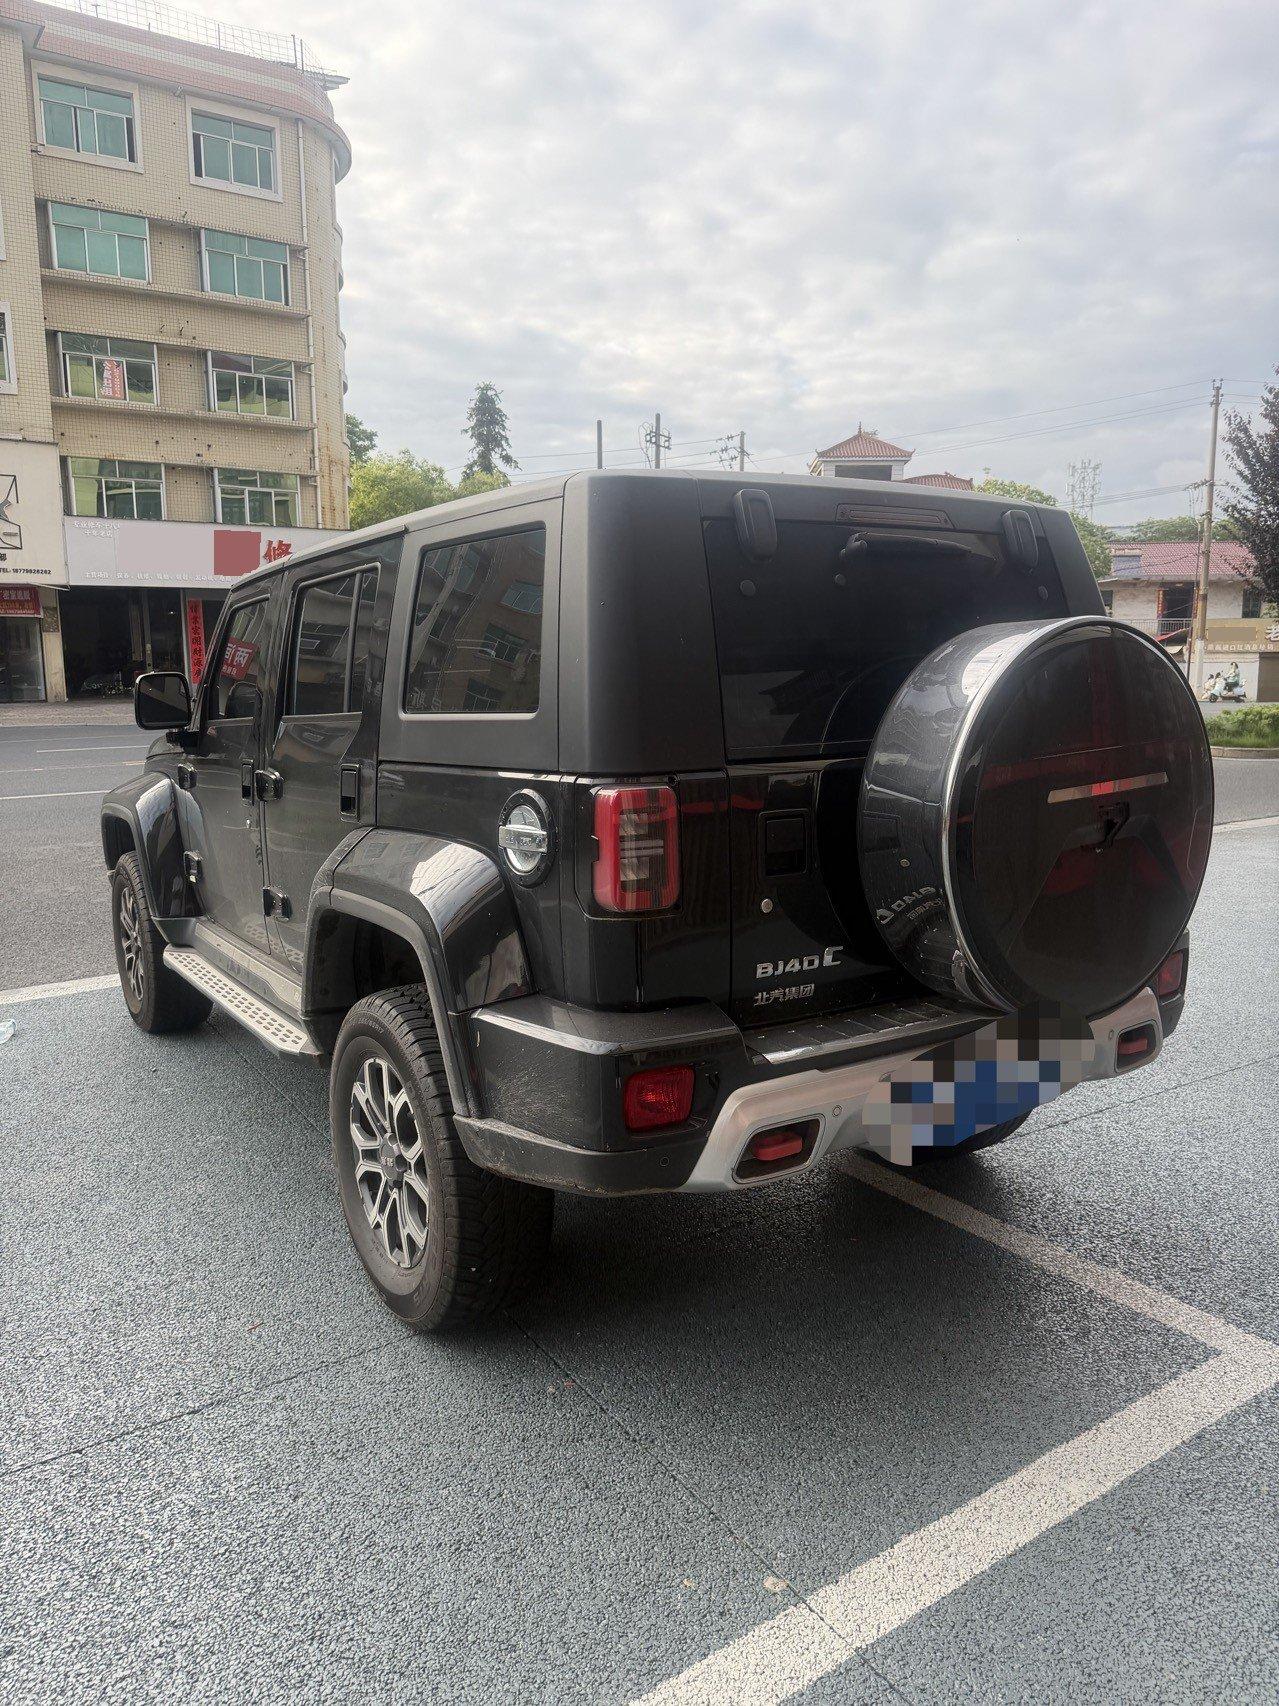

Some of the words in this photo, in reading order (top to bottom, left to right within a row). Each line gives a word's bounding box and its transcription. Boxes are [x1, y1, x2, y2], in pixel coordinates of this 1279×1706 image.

[263, 539, 293, 564] 修
[753, 983, 816, 1007] 北汽集团
